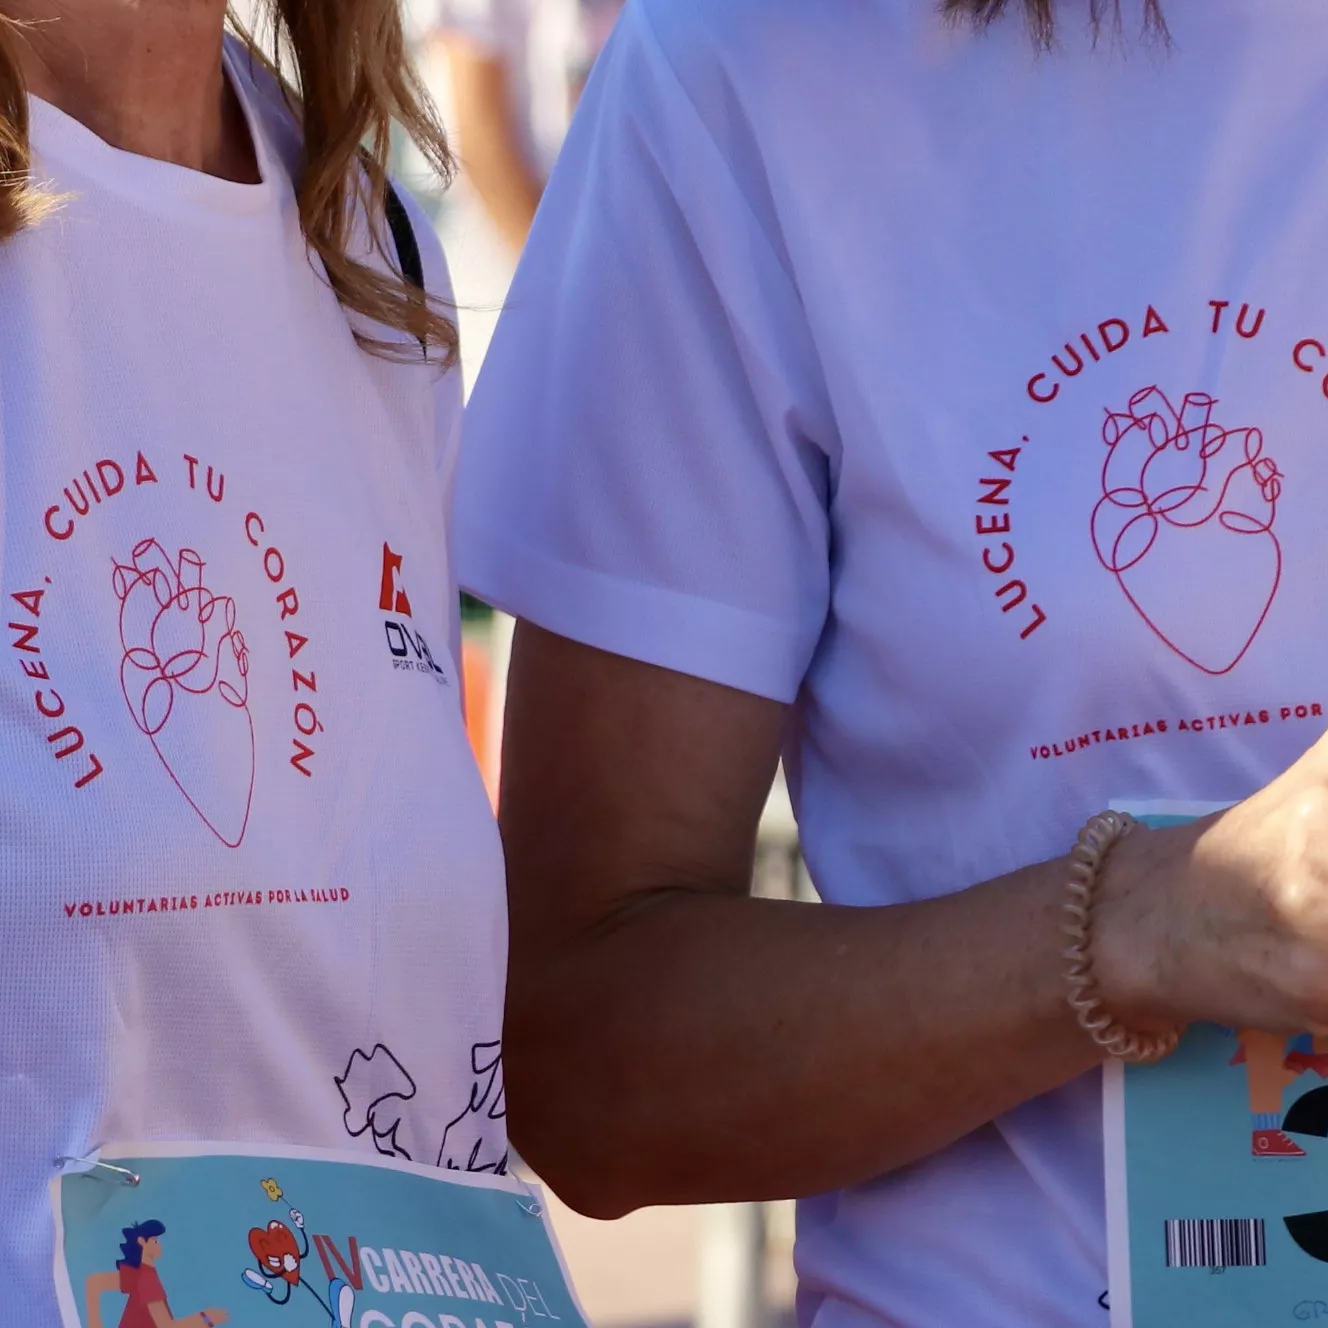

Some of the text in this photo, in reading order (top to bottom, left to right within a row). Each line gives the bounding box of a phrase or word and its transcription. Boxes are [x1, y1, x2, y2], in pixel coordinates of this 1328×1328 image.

[1026, 304, 1169, 404] CUIDA
[1208, 299, 1266, 340] TU
[43, 451, 158, 540] CUIDA
[183, 454, 225, 503] TU
[244, 512, 325, 777] CORAZÓN
[1029, 719, 1169, 760] VOLUNTARIAS
[1177, 709, 1270, 732] ACTIVAS
[1279, 702, 1323, 720] POR
[64, 887, 350, 918] VOLUNTARIAS ACTIVAS POR LA SALUD
[312, 1234, 561, 1321] IV CARRERA DEL
